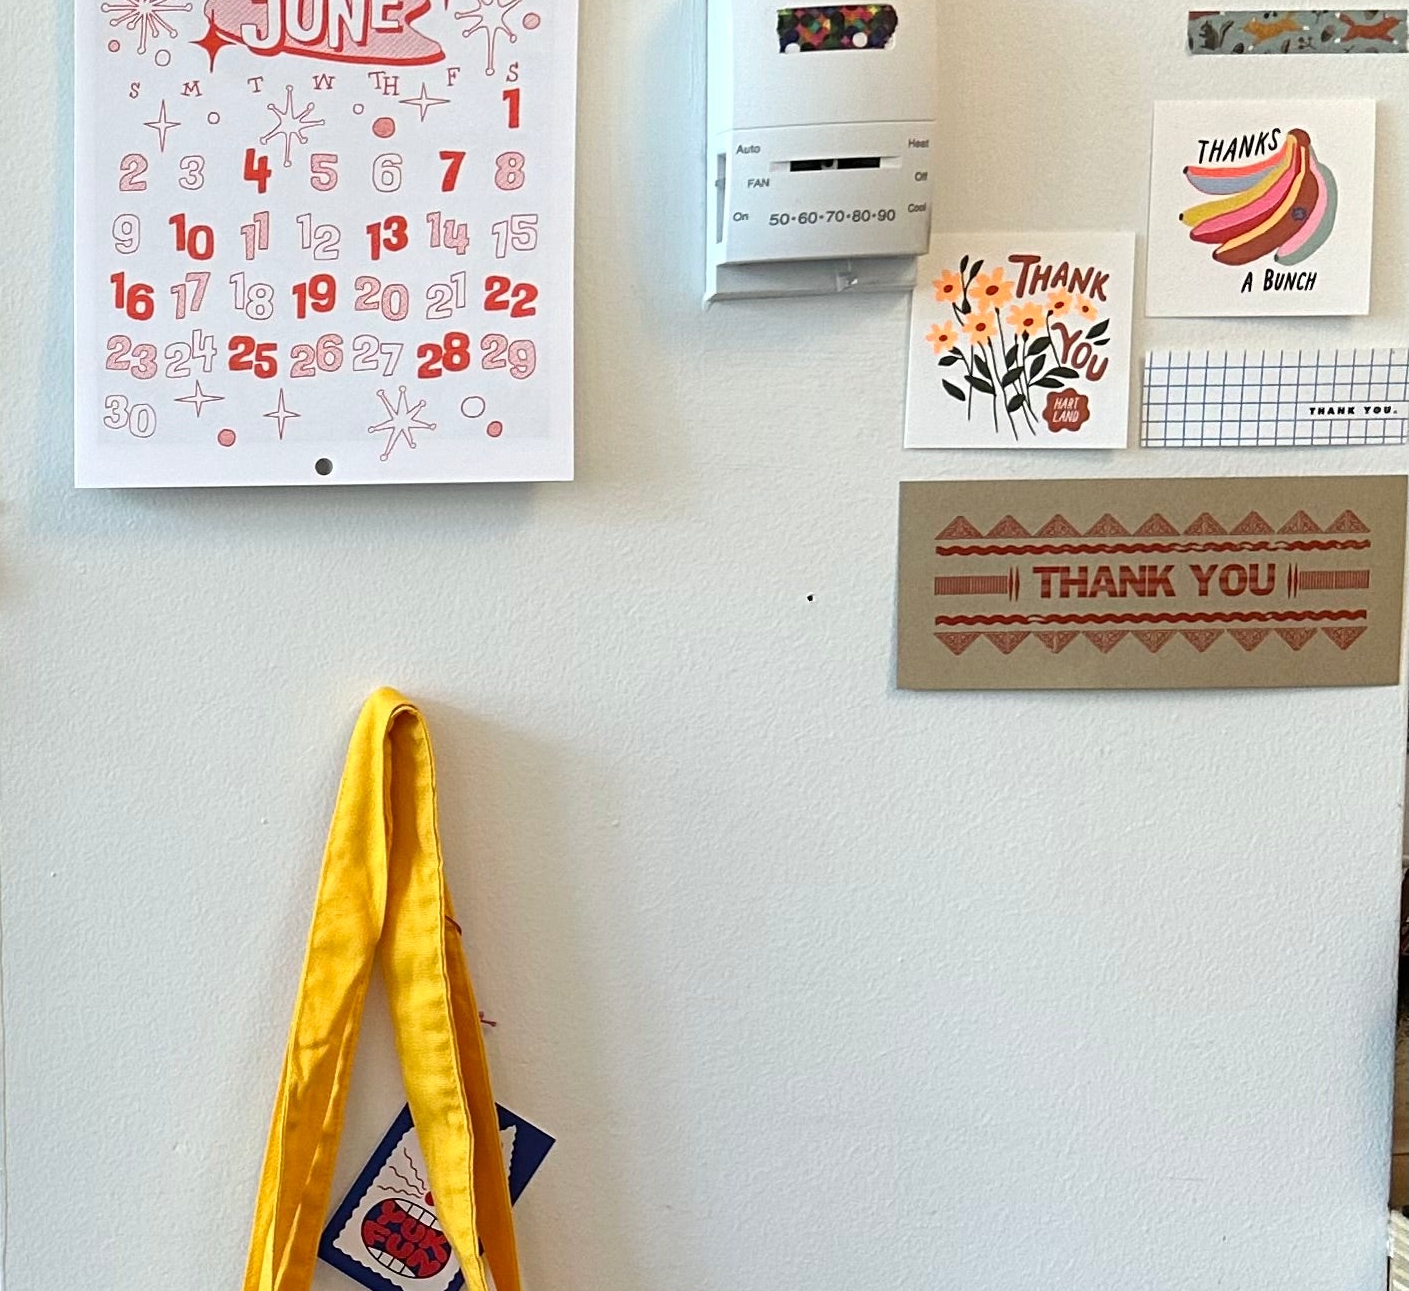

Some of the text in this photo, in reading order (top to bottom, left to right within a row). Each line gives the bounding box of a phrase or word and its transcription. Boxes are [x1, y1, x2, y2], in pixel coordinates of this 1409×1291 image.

[129, 63, 519, 98] S M T W TH F S
[503, 89, 521, 128] 1
[735, 145, 761, 155] Auto
[908, 138, 930, 148] Heat
[1198, 128, 1281, 164] THANKS
[119, 149, 525, 193] 2 3 4 5 6 7 8
[747, 178, 770, 188] FAN
[914, 172, 928, 182] Off
[733, 212, 749, 222] On
[907, 203, 927, 213] Cool
[113, 212, 538, 260] 9 10 11 12 13 14 15
[110, 271, 538, 321] 16 17 18 19 20 21 22
[1008, 254, 1110, 302] THANK
[1241, 270, 1317, 293] A BUNCH
[106, 329, 536, 380] 23 24 25 26 27 28 29
[1051, 322, 1109, 381] YOU
[103, 395, 156, 438] 30
[1052, 410, 1080, 423] LAND
[1053, 397, 1080, 410] HART
[1309, 405, 1398, 416] THANK YOU.
[1032, 563, 1276, 599] THANK YOU
[363, 1219, 441, 1277] FUN
[376, 1200, 448, 1263] YUK
